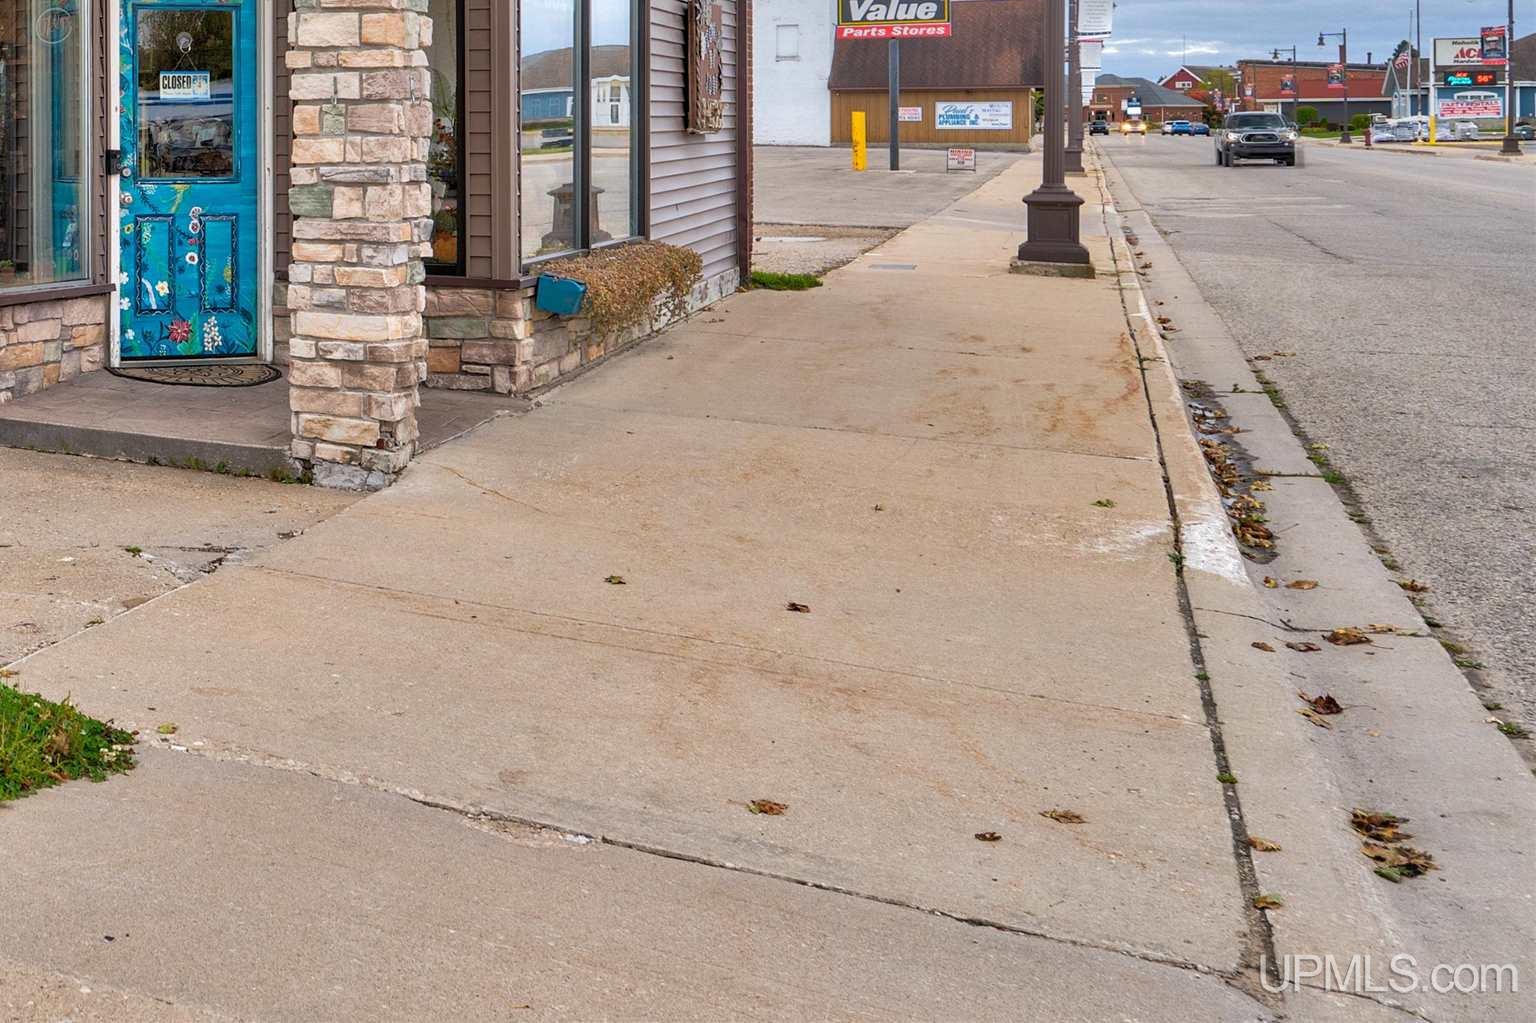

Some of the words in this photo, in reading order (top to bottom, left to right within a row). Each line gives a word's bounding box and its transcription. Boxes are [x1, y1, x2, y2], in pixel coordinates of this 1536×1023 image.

[842, 27, 886, 37] Parts
[891, 26, 945, 36] Stores
[162, 75, 192, 89] CLOSED
